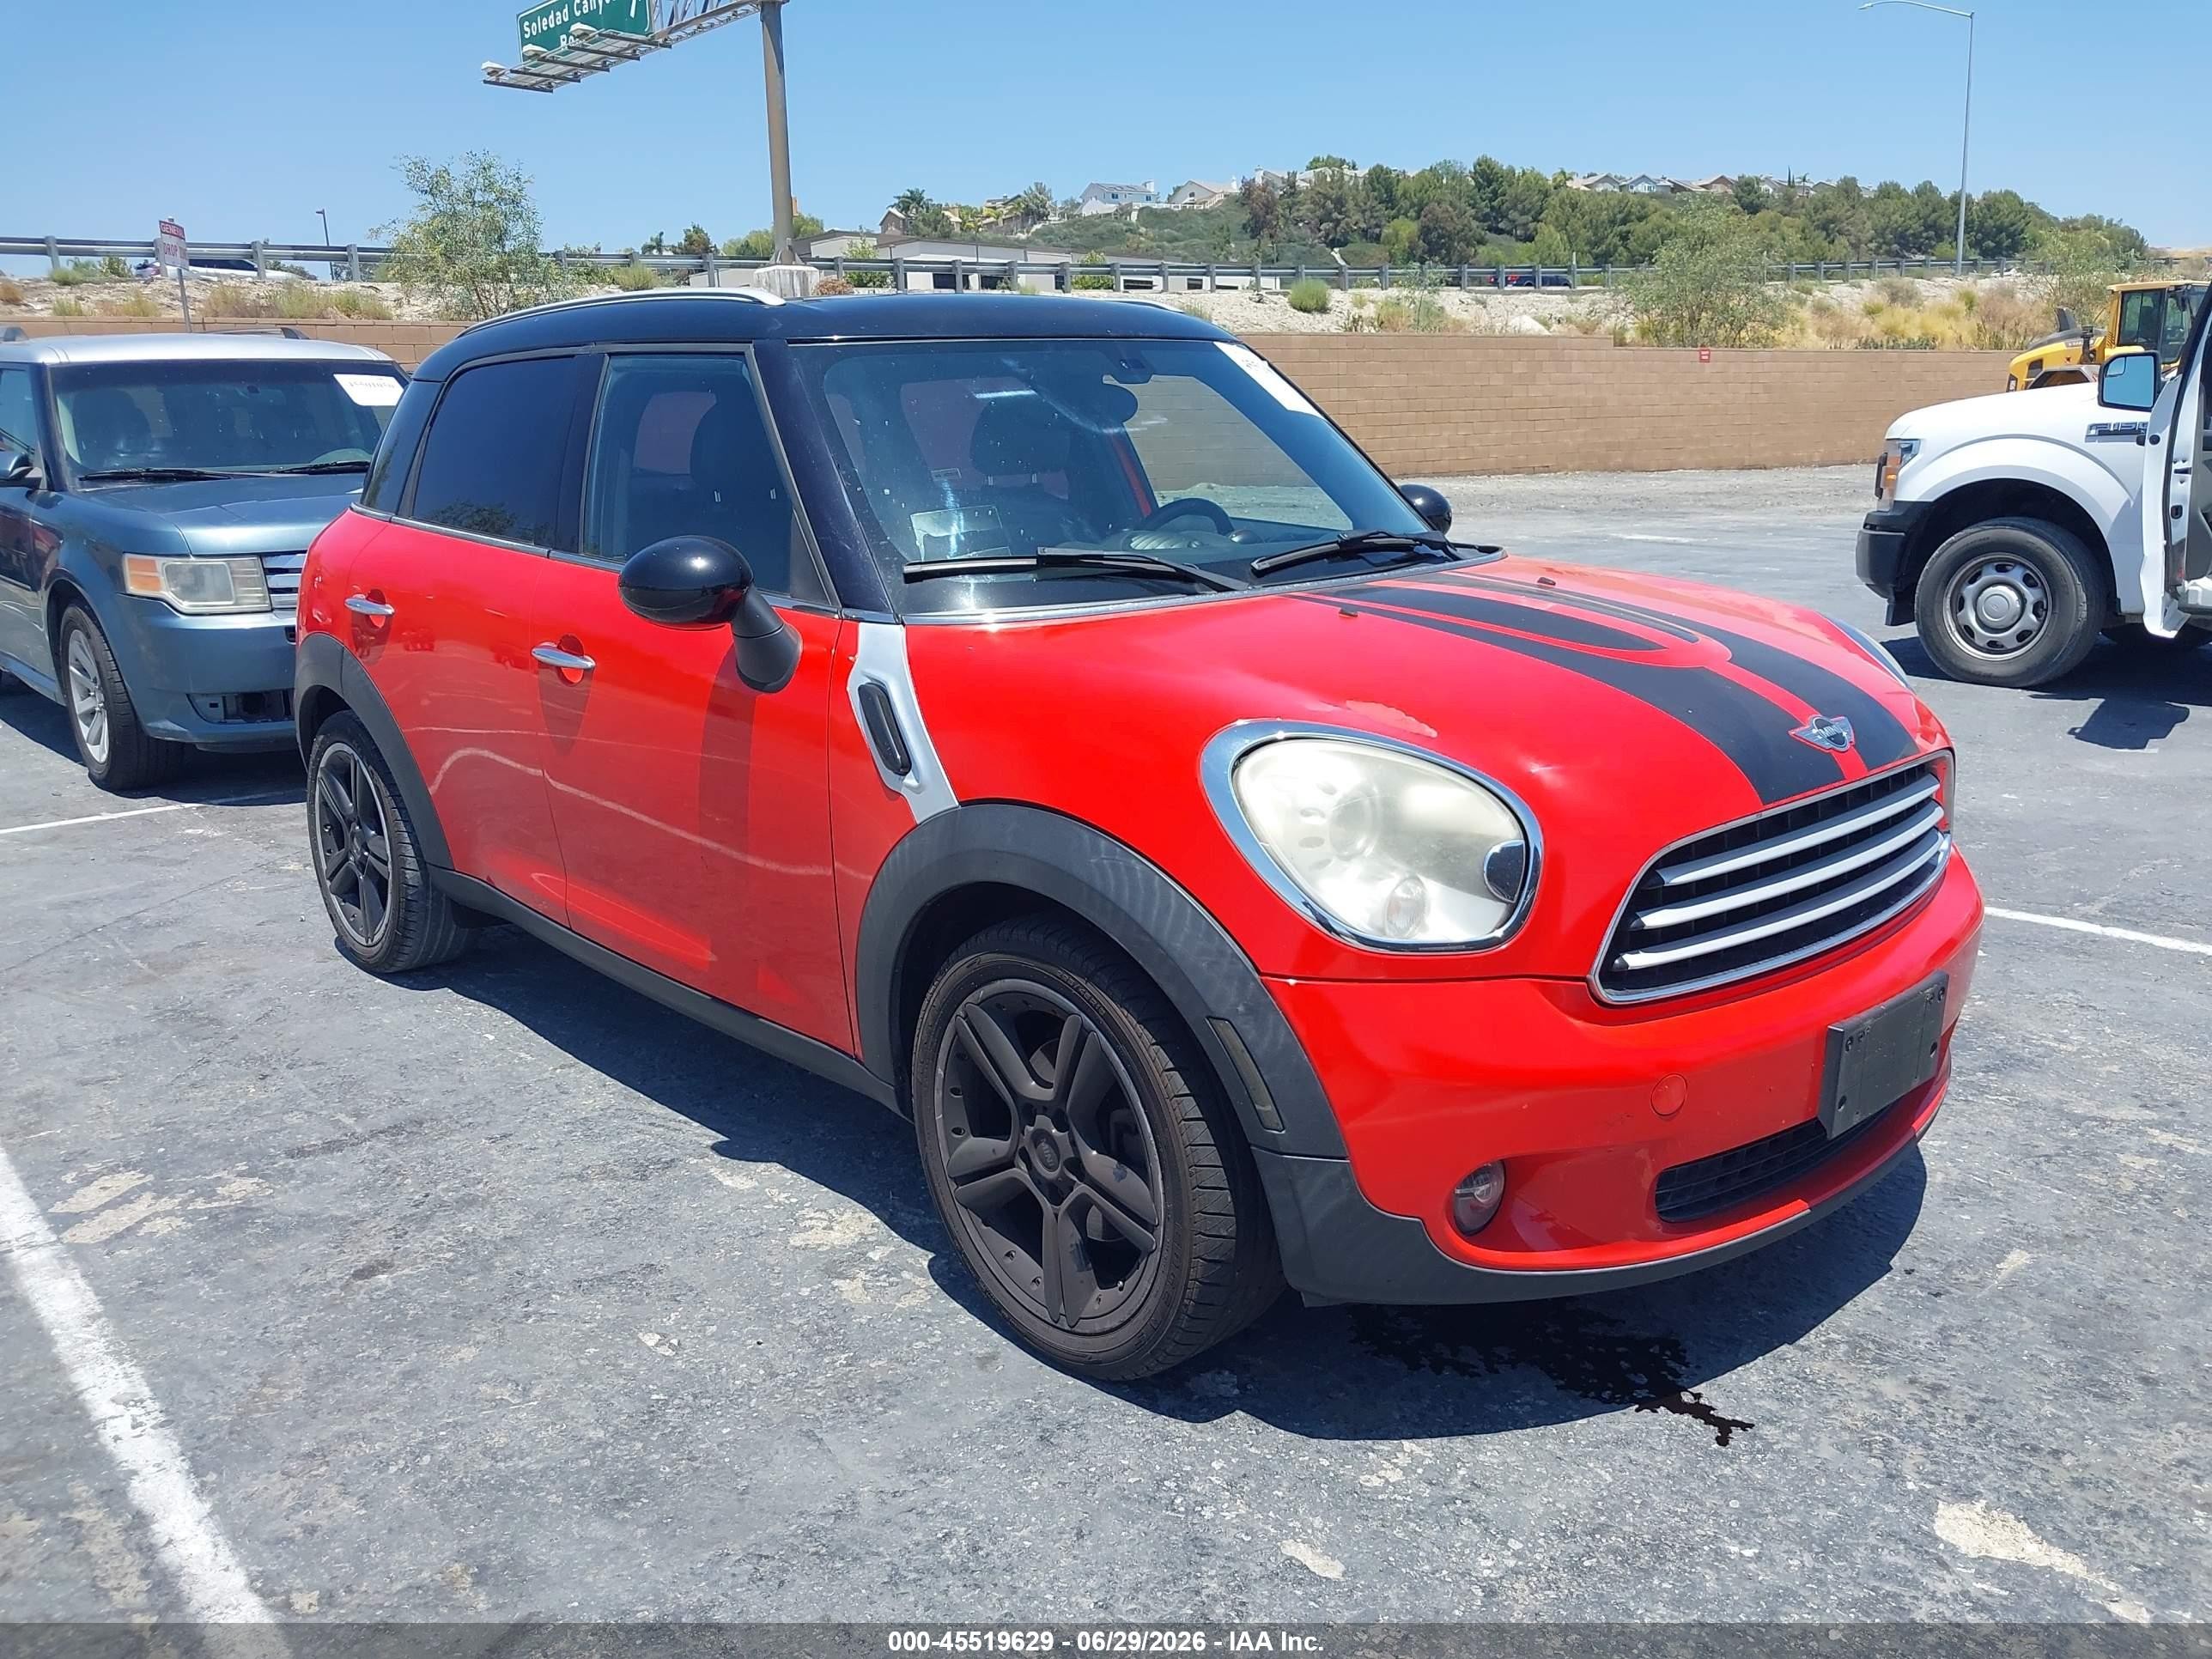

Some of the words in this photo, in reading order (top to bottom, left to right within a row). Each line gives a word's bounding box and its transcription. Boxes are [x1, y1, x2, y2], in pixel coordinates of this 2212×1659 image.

[523, 3, 568, 39] Soledad
[574, 0, 616, 16] Cany
[1041, 1138, 1055, 1167] MINI
